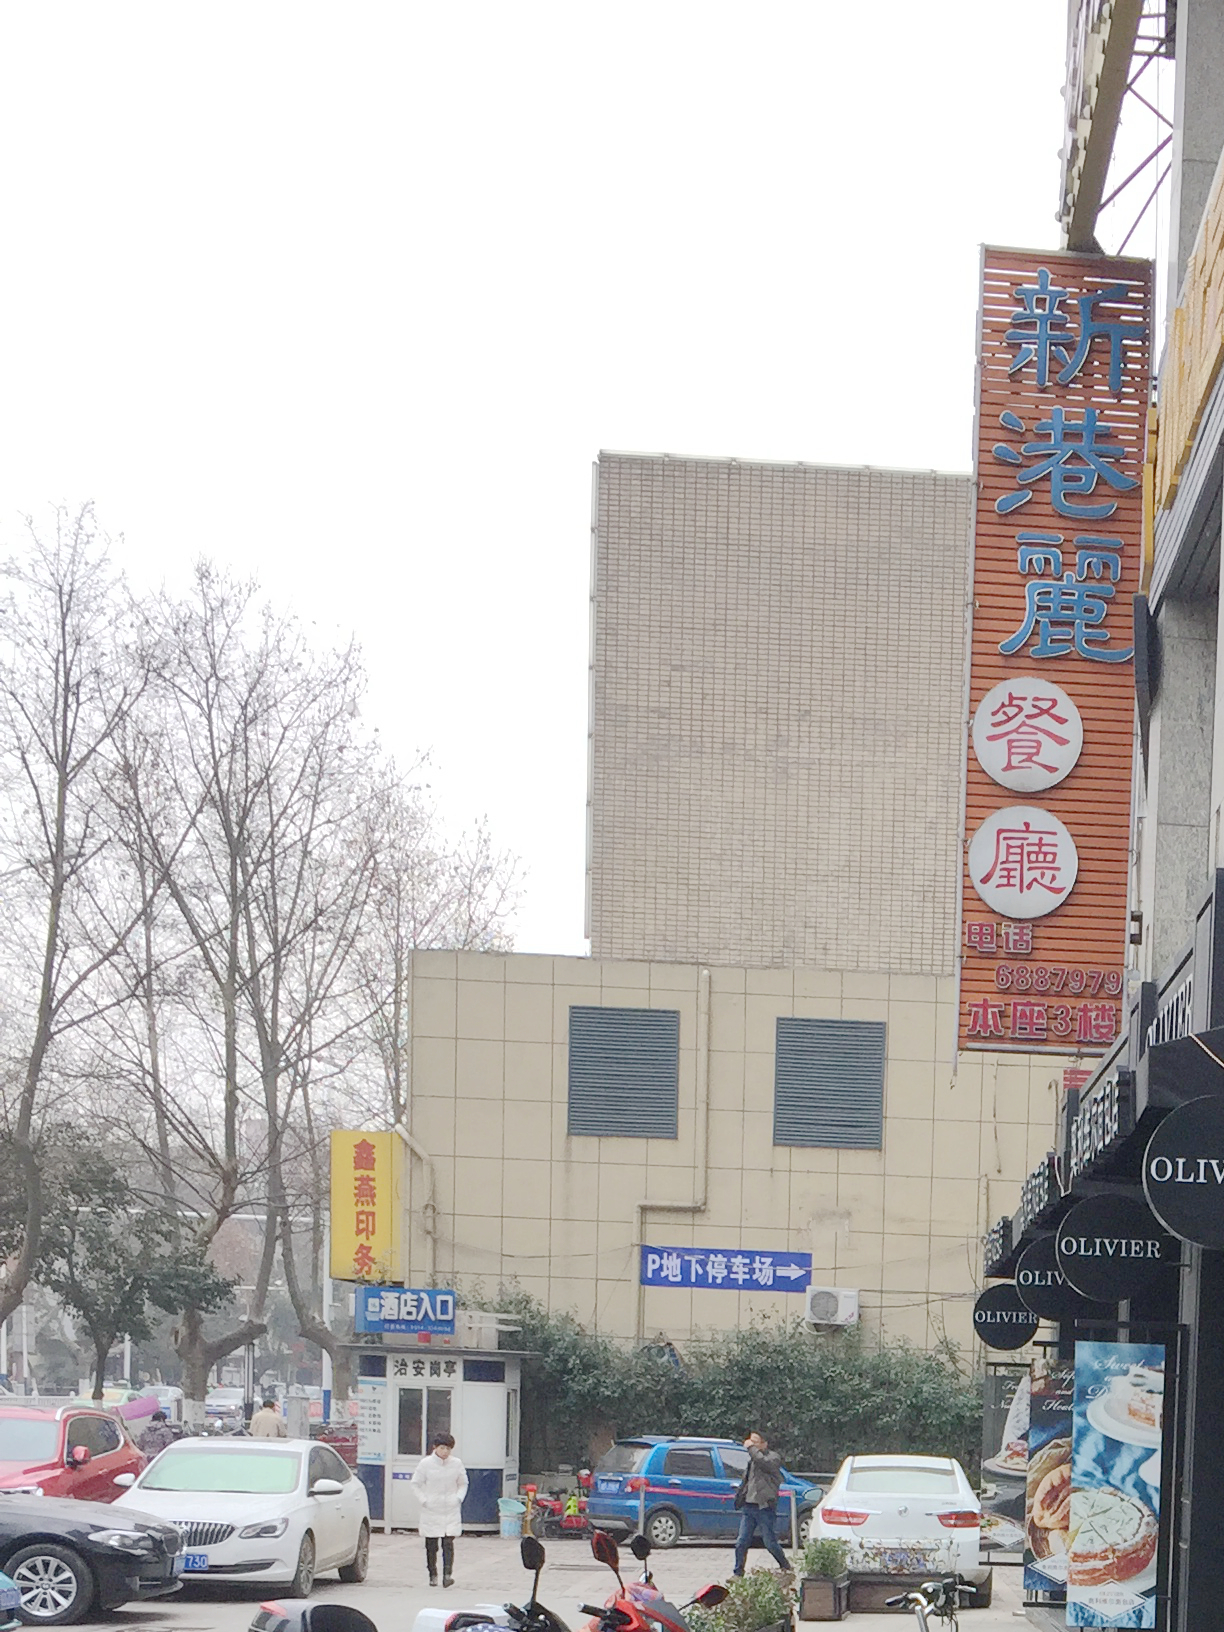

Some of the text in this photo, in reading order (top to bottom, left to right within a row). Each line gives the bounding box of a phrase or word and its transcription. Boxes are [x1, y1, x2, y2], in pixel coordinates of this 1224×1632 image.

[966, 922, 1032, 952] 电话
[995, 964, 1123, 995] 6887979
[966, 998, 1116, 1043] 本座3楼
[353, 1138, 376, 1275] 鑫燕印务
[1060, 1236, 1161, 1259] OLIVIER
[646, 1252, 774, 1286] P地下停车场
[1019, 1269, 1072, 1287] OLIV
[379, 1291, 454, 1321] 酒店入口
[974, 1310, 1038, 1325] OLIVIER
[394, 1358, 457, 1378] 治安岗亭
